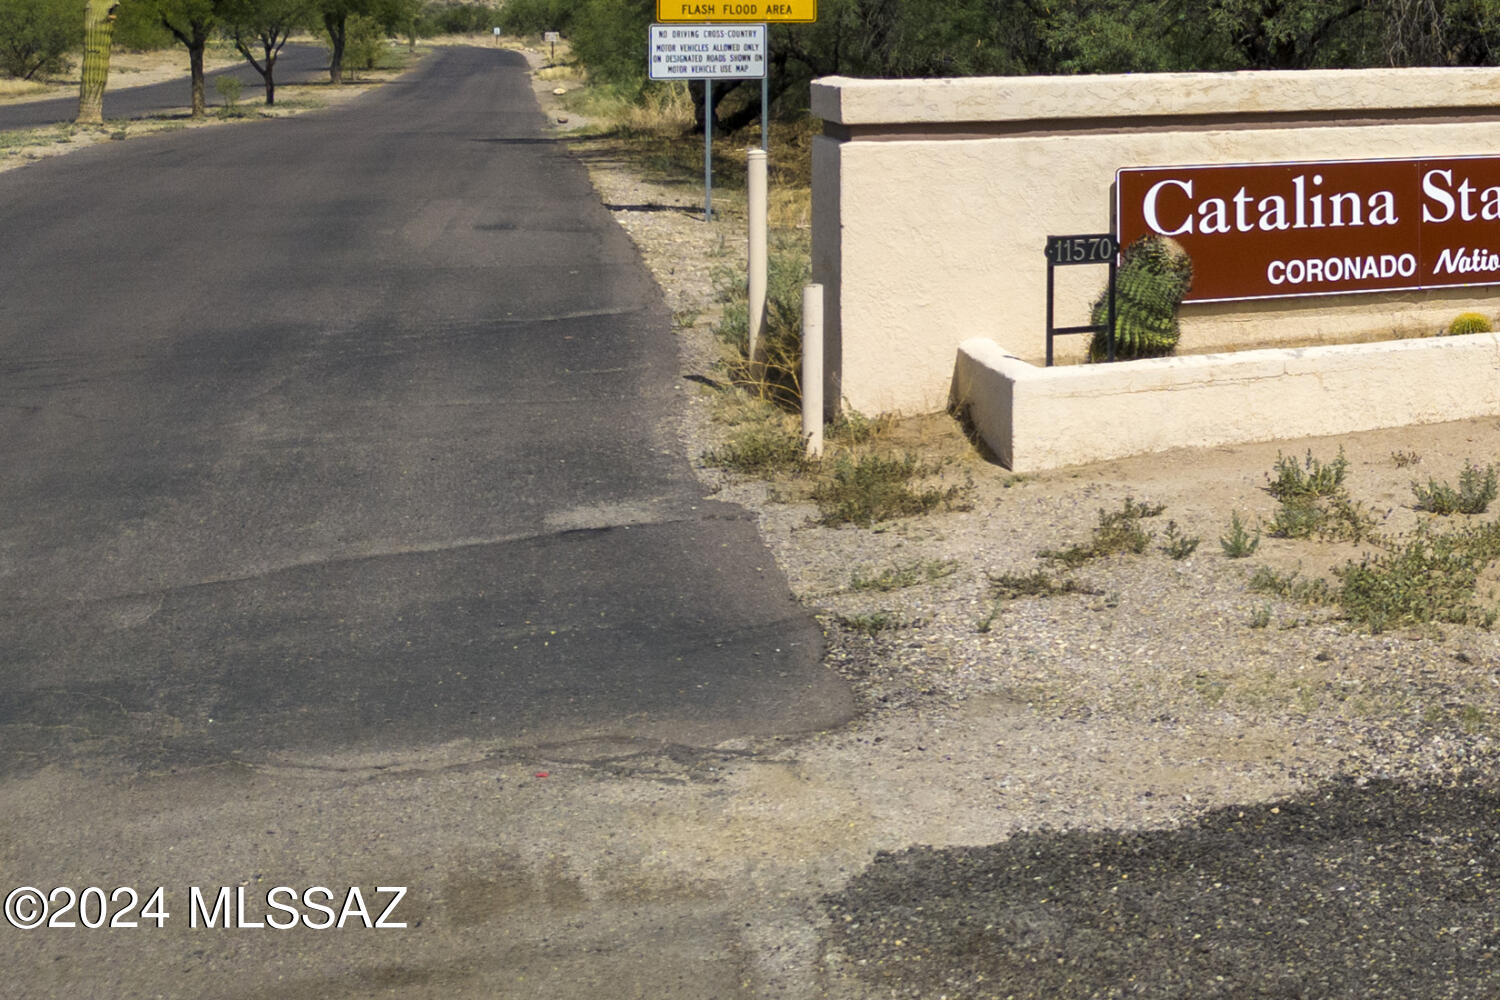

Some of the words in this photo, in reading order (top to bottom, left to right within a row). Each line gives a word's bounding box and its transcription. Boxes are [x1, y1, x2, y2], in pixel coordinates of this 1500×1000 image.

[682, 5, 715, 14] FLASH
[723, 5, 757, 14] FLOOD
[766, 5, 792, 14] AREA
[672, 30, 699, 38] DRIVING
[656, 44, 675, 52] MOTOR
[1143, 173, 1398, 236] Catalina
[1055, 238, 1111, 261] 11570
[1267, 254, 1417, 286] CORONADO
